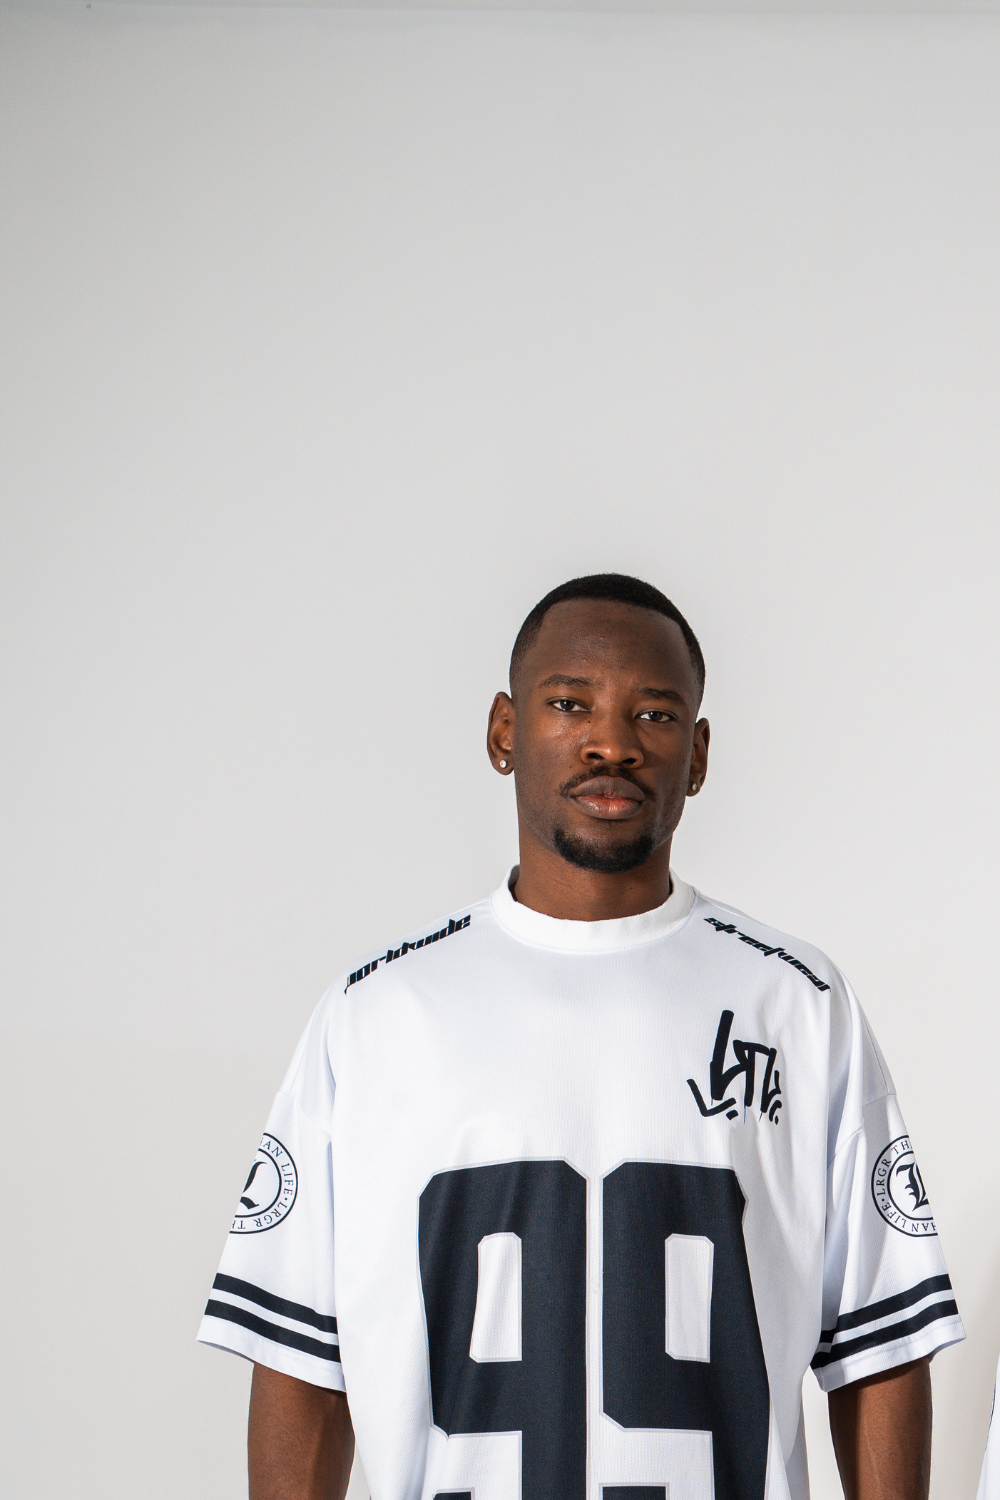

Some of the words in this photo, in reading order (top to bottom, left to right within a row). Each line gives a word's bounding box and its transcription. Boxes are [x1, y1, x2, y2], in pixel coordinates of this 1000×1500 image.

[281, 1163, 294, 1196] LIFE
[876, 1158, 892, 1197] LRGR
[253, 1201, 288, 1228] LRGR
[882, 1202, 907, 1228] LIFE
